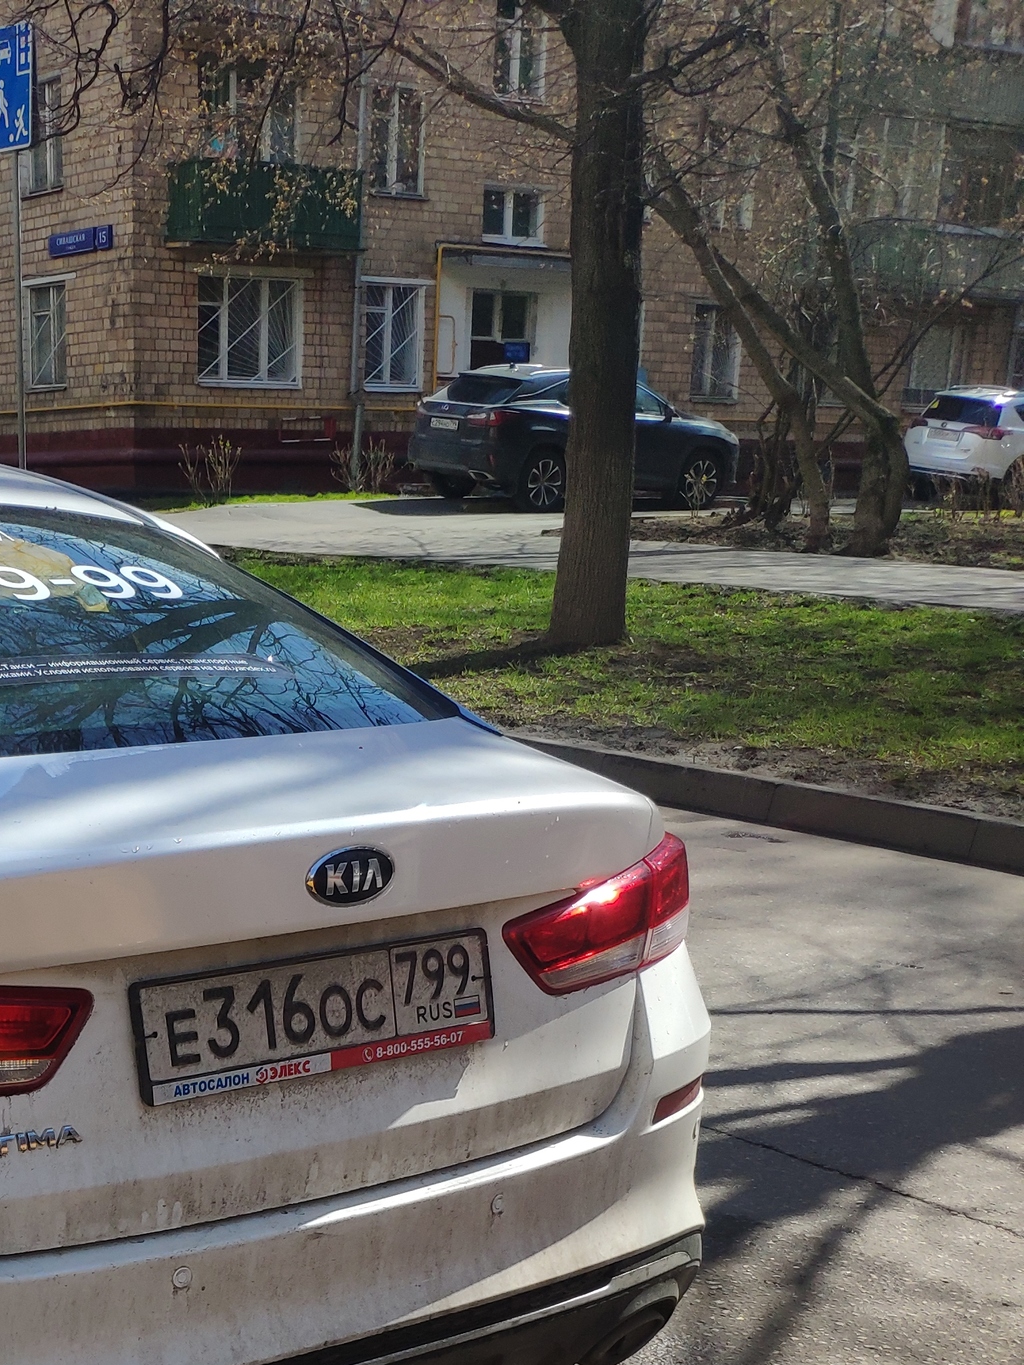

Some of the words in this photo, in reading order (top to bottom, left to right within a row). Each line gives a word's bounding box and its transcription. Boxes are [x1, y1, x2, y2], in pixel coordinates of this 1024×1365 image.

[98, 231, 107, 244] 15
[34, 668, 82, 676] Условия
[81, 665, 158, 674] использования
[159, 665, 201, 673] сервиса
[47, 657, 142, 668] информационный
[324, 858, 383, 896] KIA
[395, 944, 471, 1007] 799
[416, 1001, 453, 1024] RUS
[376, 1031, 464, 1058] 8-800-555-56-07
[173, 1072, 250, 1098] АВТОСАЛОН
[270, 1060, 311, 1080] ЭЛЕКС
